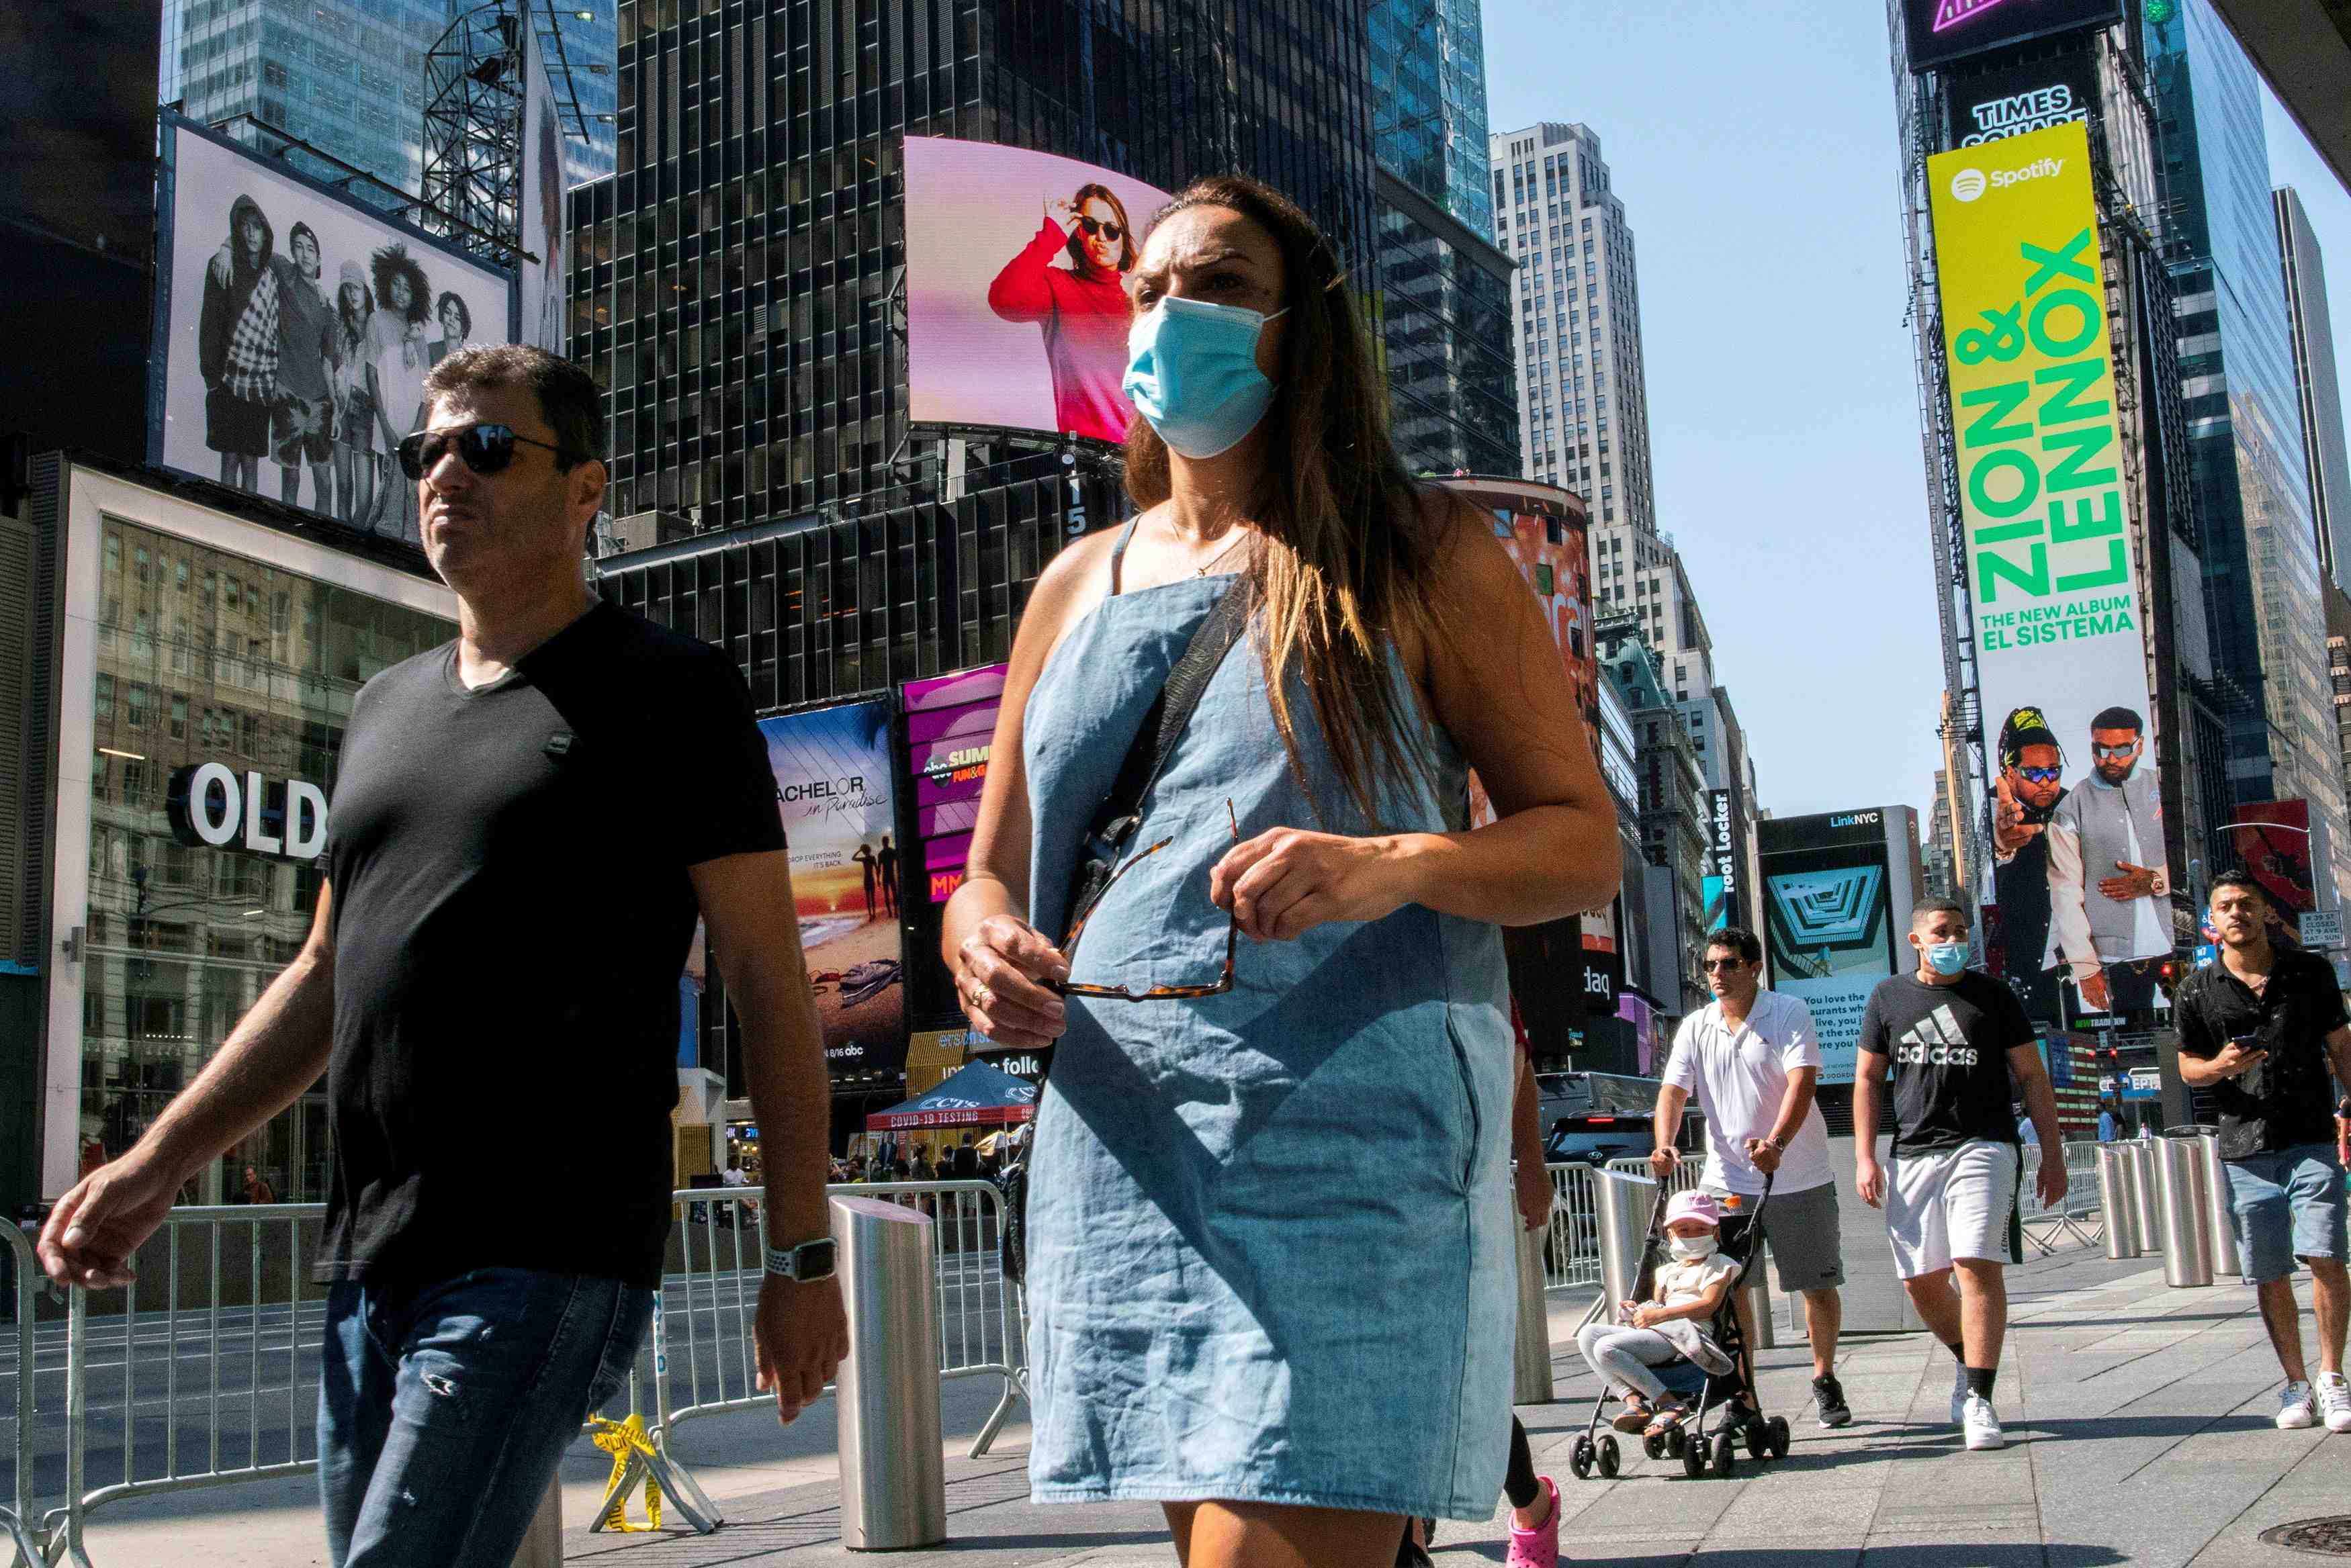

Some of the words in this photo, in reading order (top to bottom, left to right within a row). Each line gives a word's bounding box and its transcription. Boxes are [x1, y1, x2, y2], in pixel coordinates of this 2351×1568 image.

[1972, 85, 2072, 130] TIMES
[1990, 158, 2064, 187] Spotify
[1954, 300, 2026, 365] &
[2021, 227, 2128, 592] LENNOX
[1961, 380, 2050, 603] ZION
[1980, 612, 2015, 629] THE
[2019, 604, 2061, 624] NEW
[2066, 595, 2131, 617] ALBUM
[1983, 630, 2013, 651] EL
[2016, 612, 2134, 646] SISTEMA
[190, 762, 328, 859] OLD
[825, 788, 887, 825] Paradise
[1830, 813, 1878, 827] LinkNYC
[1714, 794, 1731, 851] Locker
[805, 851, 841, 862] EVERYTHING
[1804, 997, 1822, 1005] You
[1825, 995, 1846, 1004] love
[1849, 994, 1865, 1002] the
[1826, 1028, 1843, 1037] the
[1838, 1017, 1856, 1027] you
[830, 1048, 844, 1058] 8/16
[845, 1045, 864, 1056] abc
[1835, 1041, 1853, 1050] you
[1898, 1042, 1978, 1065] adidas
[891, 1113, 934, 1127] COVID-19
[938, 1111, 979, 1123] TESTING
